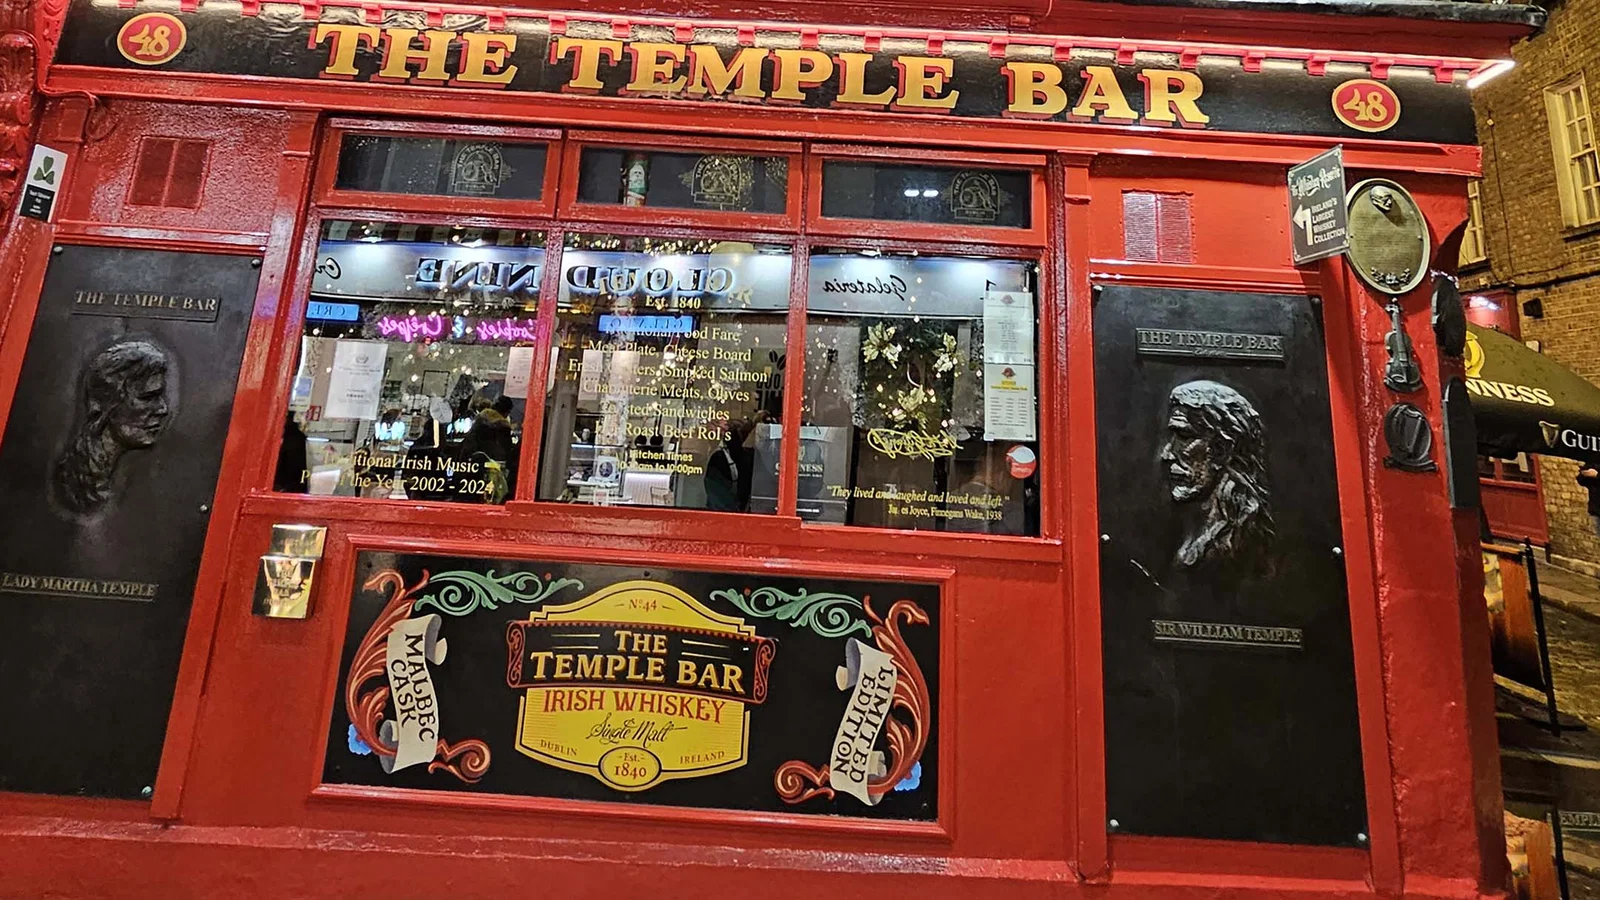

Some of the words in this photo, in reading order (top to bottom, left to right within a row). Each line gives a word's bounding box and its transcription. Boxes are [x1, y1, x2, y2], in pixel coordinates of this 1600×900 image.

[129, 23, 170, 57] 48
[312, 23, 518, 87] THE
[553, 37, 959, 112] TEMPLE
[1006, 62, 1210, 126] BAR
[1343, 90, 1388, 123] 48
[1312, 209, 1335, 224] LARGEST
[1313, 220, 1336, 233] WHISKEY
[1314, 227, 1345, 244] COLLECTION
[75, 291, 105, 305] THE
[113, 293, 180, 309] TEMPLE
[183, 297, 217, 311] BAR
[645, 296, 669, 308] Est.
[1138, 330, 1173, 345] THE
[1175, 332, 1244, 349] TEMPLE
[1246, 335, 1283, 351] BAR
[713, 347, 751, 361] Board
[663, 365, 715, 380] Smoked
[719, 367, 767, 382] Salmon
[661, 384, 703, 400] Meats,
[708, 385, 750, 402] Olives
[1465, 378, 1555, 407] NNESS
[654, 403, 730, 421] Sandwiches
[625, 422, 659, 437] Roast
[663, 425, 696, 439] Beef
[698, 426, 732, 441] Rols
[400, 454, 432, 471] Irish
[436, 456, 480, 473] Music
[410, 475, 446, 492] 2002
[458, 478, 495, 495] 2024
[853, 486, 875, 499] lived
[927, 491, 945, 503] and
[945, 491, 969, 505] loved
[969, 493, 987, 507] and
[986, 510, 1003, 521] 1938
[1, 574, 40, 589] LADY
[40, 577, 99, 593] MARTHA
[101, 581, 157, 597] TEMPLE
[614, 630, 669, 654] THE
[1154, 621, 1178, 636] SIR
[1178, 623, 1244, 641] WILLIAM
[1245, 627, 1301, 643] TEMPLE
[530, 651, 666, 682] TEMPLE
[676, 660, 746, 695] BAR
[390, 659, 416, 728] CASK
[404, 633, 436, 742] MALBEC
[543, 689, 606, 713] IRISH
[613, 690, 726, 724] WHISKEY
[585, 712, 633, 745] Single
[631, 720, 682, 748] Malt
[832, 672, 876, 776] EDITION
[848, 666, 894, 784] LIMITED
[540, 738, 578, 757] DUBLIN
[679, 750, 725, 765] IRELAND
[614, 762, 647, 780] 1840
